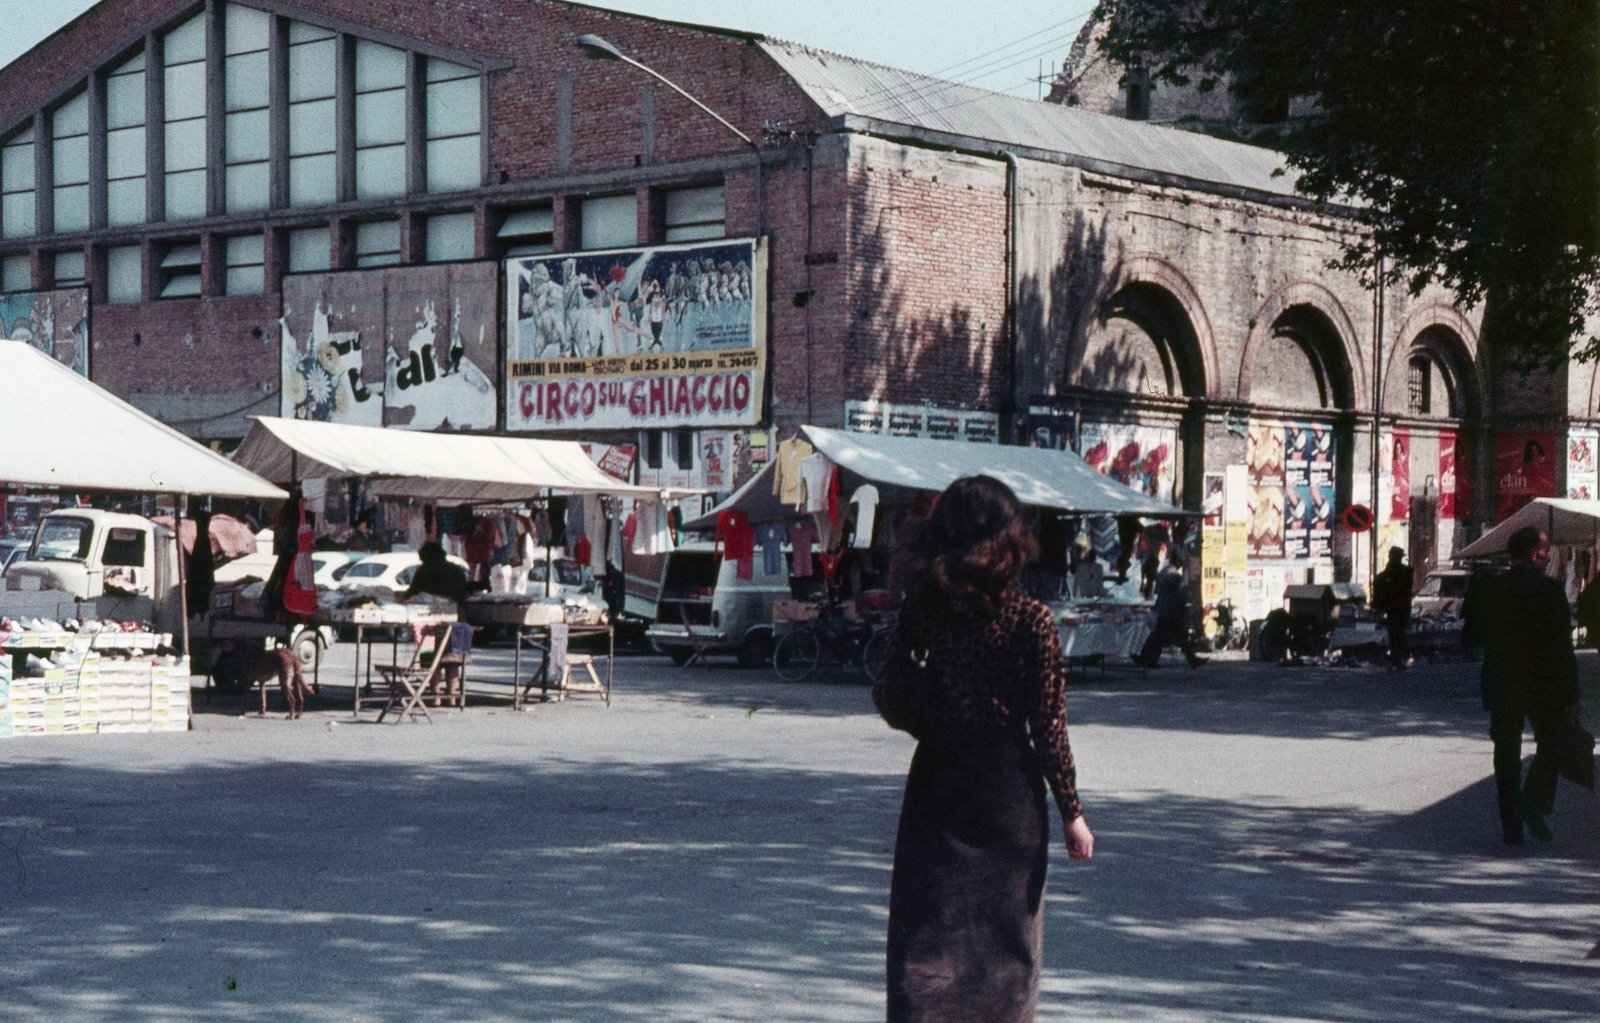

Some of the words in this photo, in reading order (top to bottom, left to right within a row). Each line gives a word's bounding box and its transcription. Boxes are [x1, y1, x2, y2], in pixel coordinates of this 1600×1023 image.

[512, 361, 545, 377] RIMINI
[548, 361, 561, 374] VIA
[563, 361, 587, 373] ROMA
[630, 358, 643, 371] dal
[645, 358, 659, 370] 25
[661, 358, 670, 370] al
[672, 357, 686, 369] 30
[688, 358, 713, 369] marzo
[520, 381, 596, 422] CIRCO
[599, 382, 626, 407] SUL
[628, 374, 749, 417] GHIACCIO
